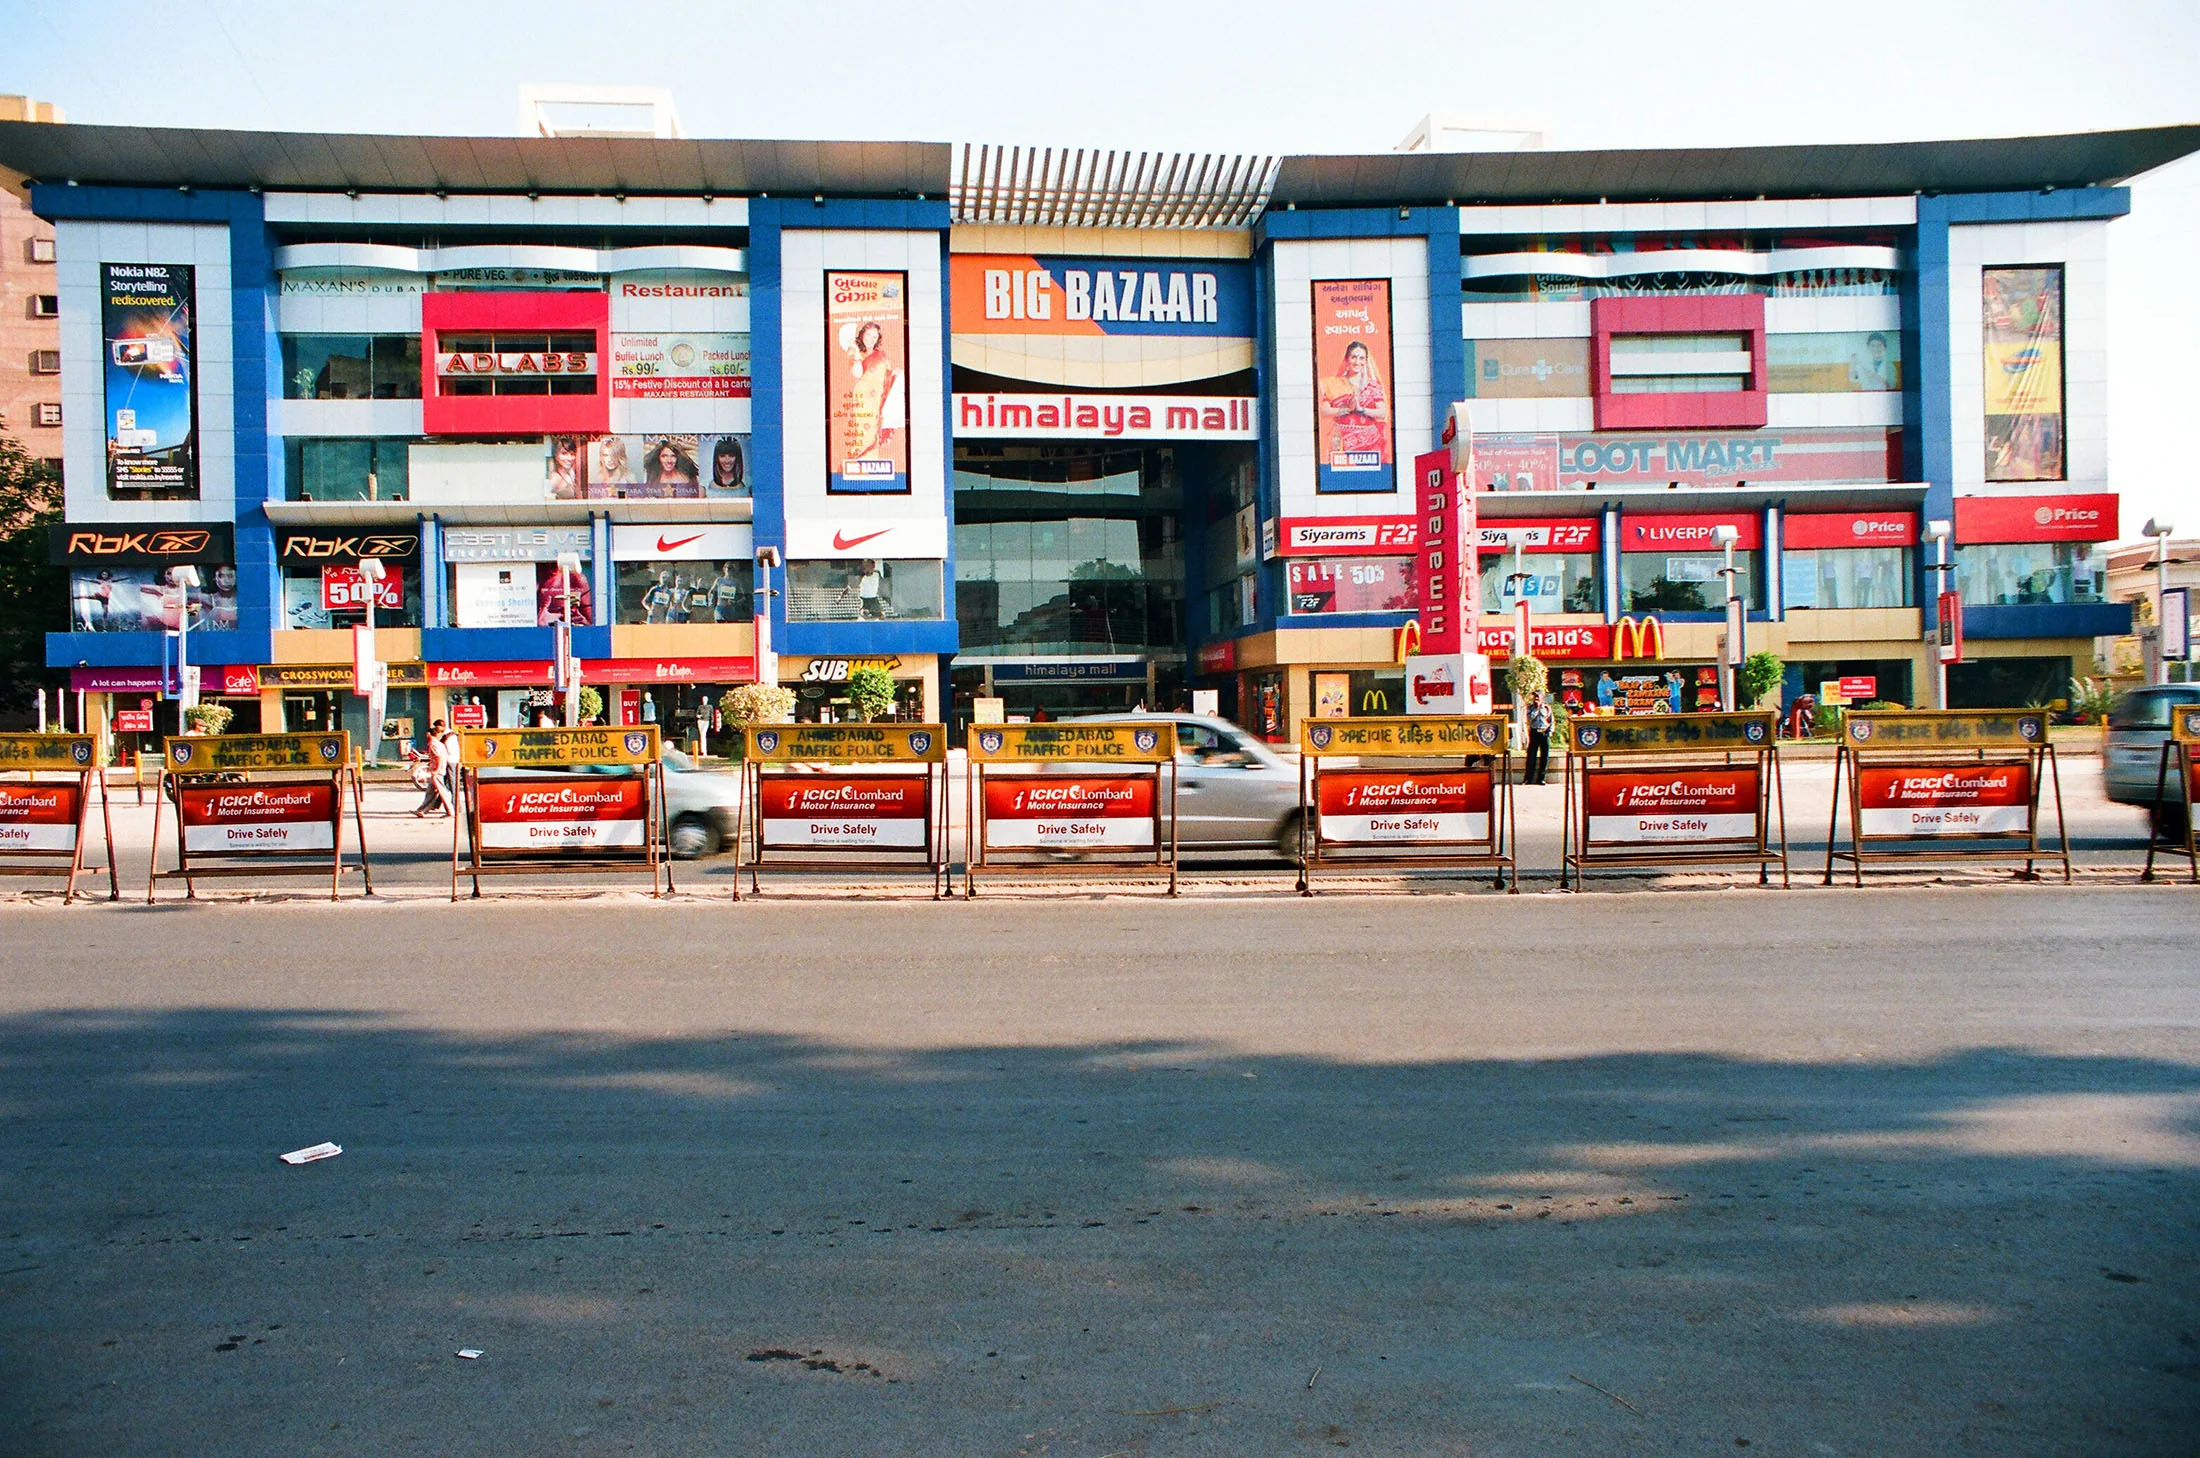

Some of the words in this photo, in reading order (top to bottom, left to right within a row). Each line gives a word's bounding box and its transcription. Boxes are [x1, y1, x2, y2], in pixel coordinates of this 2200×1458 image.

[110, 266, 143, 277] Nokia
[144, 267, 169, 278] N82.
[453, 270, 481, 280] PURE
[110, 280, 167, 293] Storytelling
[282, 280, 366, 293] MAXAN'S
[372, 285, 424, 293] DUBAI
[622, 283, 743, 297] Restaurant
[834, 278, 878, 291] બુધવાર
[1540, 282, 1578, 294] Sound
[111, 295, 176, 306] rediscovered.
[834, 292, 878, 303] બજાર
[984, 269, 1051, 320] BIG
[1065, 269, 1218, 324] BAZAAR
[621, 337, 658, 347] Unlimited
[446, 351, 589, 373] ADLABS
[615, 351, 638, 362] Buffet
[640, 351, 664, 362] Lunch
[703, 350, 729, 361] Packed
[614, 381, 630, 390] 15%
[633, 380, 662, 390] Festive
[664, 379, 700, 389] Discount
[702, 381, 712, 389] on
[715, 381, 721, 389] a
[722, 380, 729, 389] la
[961, 395, 1151, 436] himalaya
[1166, 399, 1250, 431] mall
[646, 433, 699, 443] MATRIX
[1559, 440, 1657, 474] LOOT
[1665, 438, 1782, 473] MART
[2054, 507, 2099, 521] Price
[1868, 521, 1905, 533] Price
[1299, 529, 1367, 544] Siyaram's
[1553, 526, 1592, 544] F2F
[1425, 469, 1446, 635] himalaya
[1292, 564, 1344, 583] SALE
[280, 670, 353, 681] CROSSWORD
[1024, 664, 1086, 678] himalaya
[1089, 663, 1117, 675] mall
[91, 679, 98, 687] A
[99, 679, 110, 687] lot
[127, 679, 157, 688] happen
[626, 710, 634, 724] 1
[519, 732, 608, 747] AHMEDABAD
[797, 729, 884, 742] AHMEDABAD
[1024, 728, 1115, 742] AHMEDABAD
[1338, 729, 1392, 744] અમદાવાદ
[219, 738, 301, 754] AHMEDABAD
[787, 744, 842, 757] TRAFFIC
[847, 743, 894, 757] POLICE
[1015, 743, 1070, 756] TRAFFIC
[1076, 743, 1124, 756] POLICE
[211, 753, 262, 767] TRAFFIC
[265, 751, 310, 766] POLICE
[512, 748, 566, 760] TRAFFIC
[571, 746, 618, 759] POLICE
[1904, 777, 1941, 789] ICICI
[1955, 775, 2008, 788] Lombard
[803, 789, 840, 801] ICICI
[853, 788, 904, 801] Lombard
[1030, 789, 1069, 801] ICICI
[1081, 787, 1133, 800] Lombard
[1362, 785, 1400, 796] ICICI
[1414, 782, 1466, 795] Lombard
[1631, 785, 1670, 797] ICICI
[1684, 783, 1736, 796] Lombard
[1901, 789, 1930, 799] Motor
[1932, 789, 1978, 799] Insurance
[8, 795, 57, 806] Lombard
[219, 795, 252, 807] ICICI
[265, 792, 311, 806] Lombard
[521, 792, 559, 804] ICICI
[573, 790, 623, 803] Lombard
[1359, 796, 1390, 806] Motor
[1390, 796, 1438, 806] Insurance
[1629, 797, 1658, 807] Motor
[1660, 797, 1706, 806] Insurance
[217, 808, 243, 816] Motor
[243, 806, 285, 815] Insurance
[518, 804, 548, 814] Motor
[549, 804, 595, 813] Insurance
[800, 801, 828, 810] Motor
[830, 801, 876, 810] Insurance
[1027, 801, 1056, 810] Motor
[1057, 801, 1104, 810] Insurance
[1370, 820, 1400, 831] Drive
[1403, 818, 1440, 831] Safely
[1912, 813, 1941, 824] Drive
[1944, 812, 1980, 825] Safely
[529, 827, 560, 838] Drive
[563, 826, 597, 838] Safely
[810, 824, 840, 834] Drive
[842, 823, 878, 837] Safely
[1037, 824, 1067, 835] Drive
[1070, 823, 1106, 836] Safely
[1639, 820, 1669, 831] Drive
[1671, 819, 1708, 832] Safely
[227, 829, 254, 839] Drive
[255, 827, 289, 839] Safely
